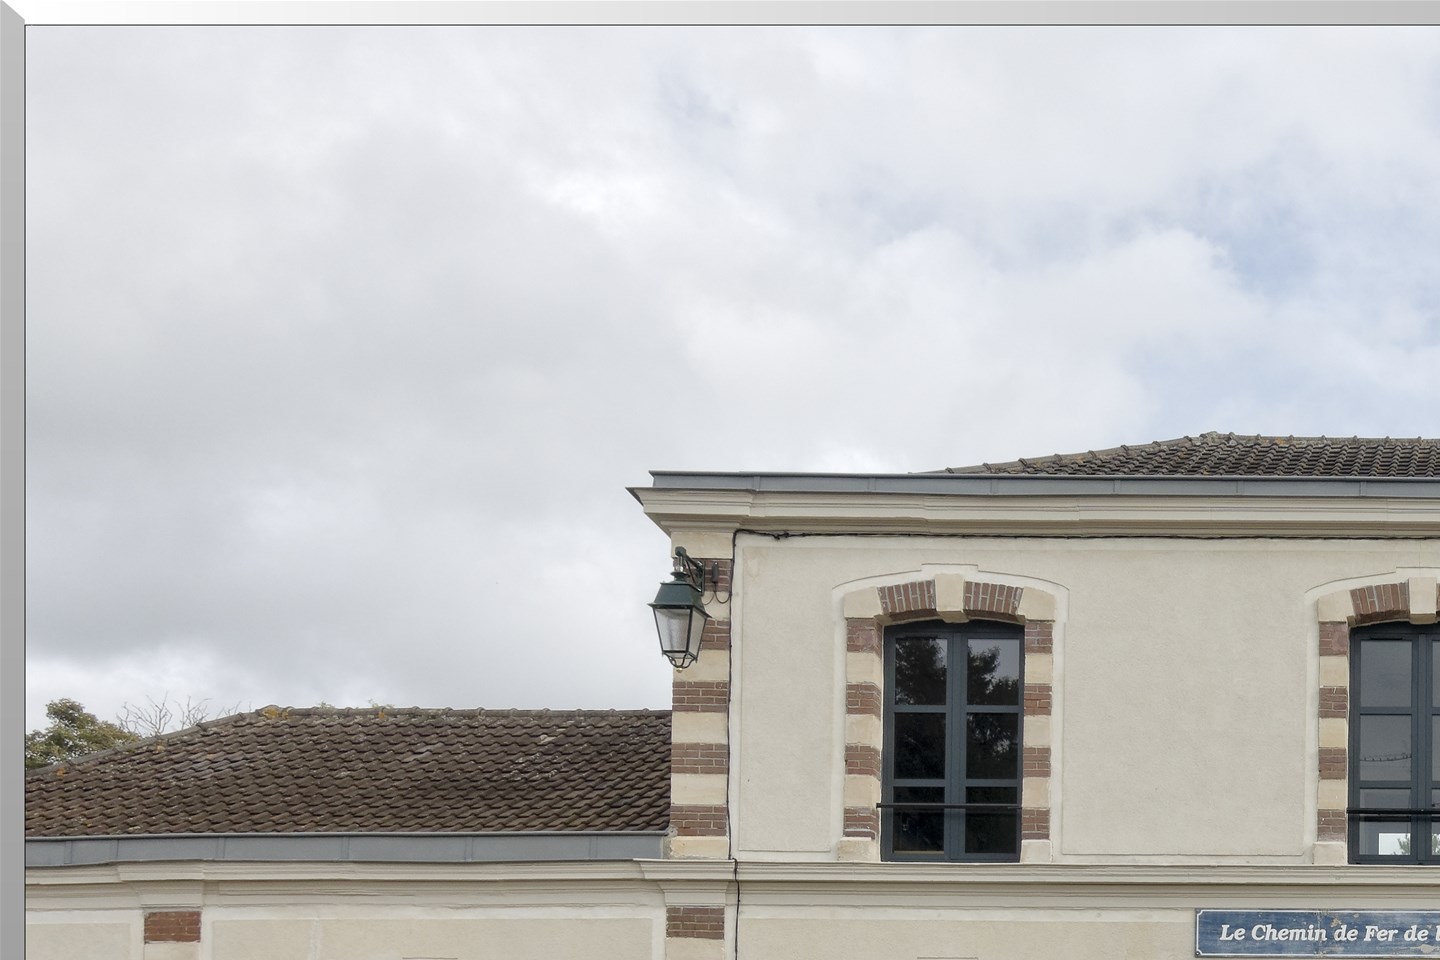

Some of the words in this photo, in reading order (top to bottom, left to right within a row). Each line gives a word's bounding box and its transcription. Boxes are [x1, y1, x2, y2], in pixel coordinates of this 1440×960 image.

[1219, 924, 1246, 941] Le
[1251, 924, 1328, 941] Chemin
[1333, 924, 1359, 941] de
[1363, 925, 1398, 942] Fer
[1403, 925, 1429, 942] de
